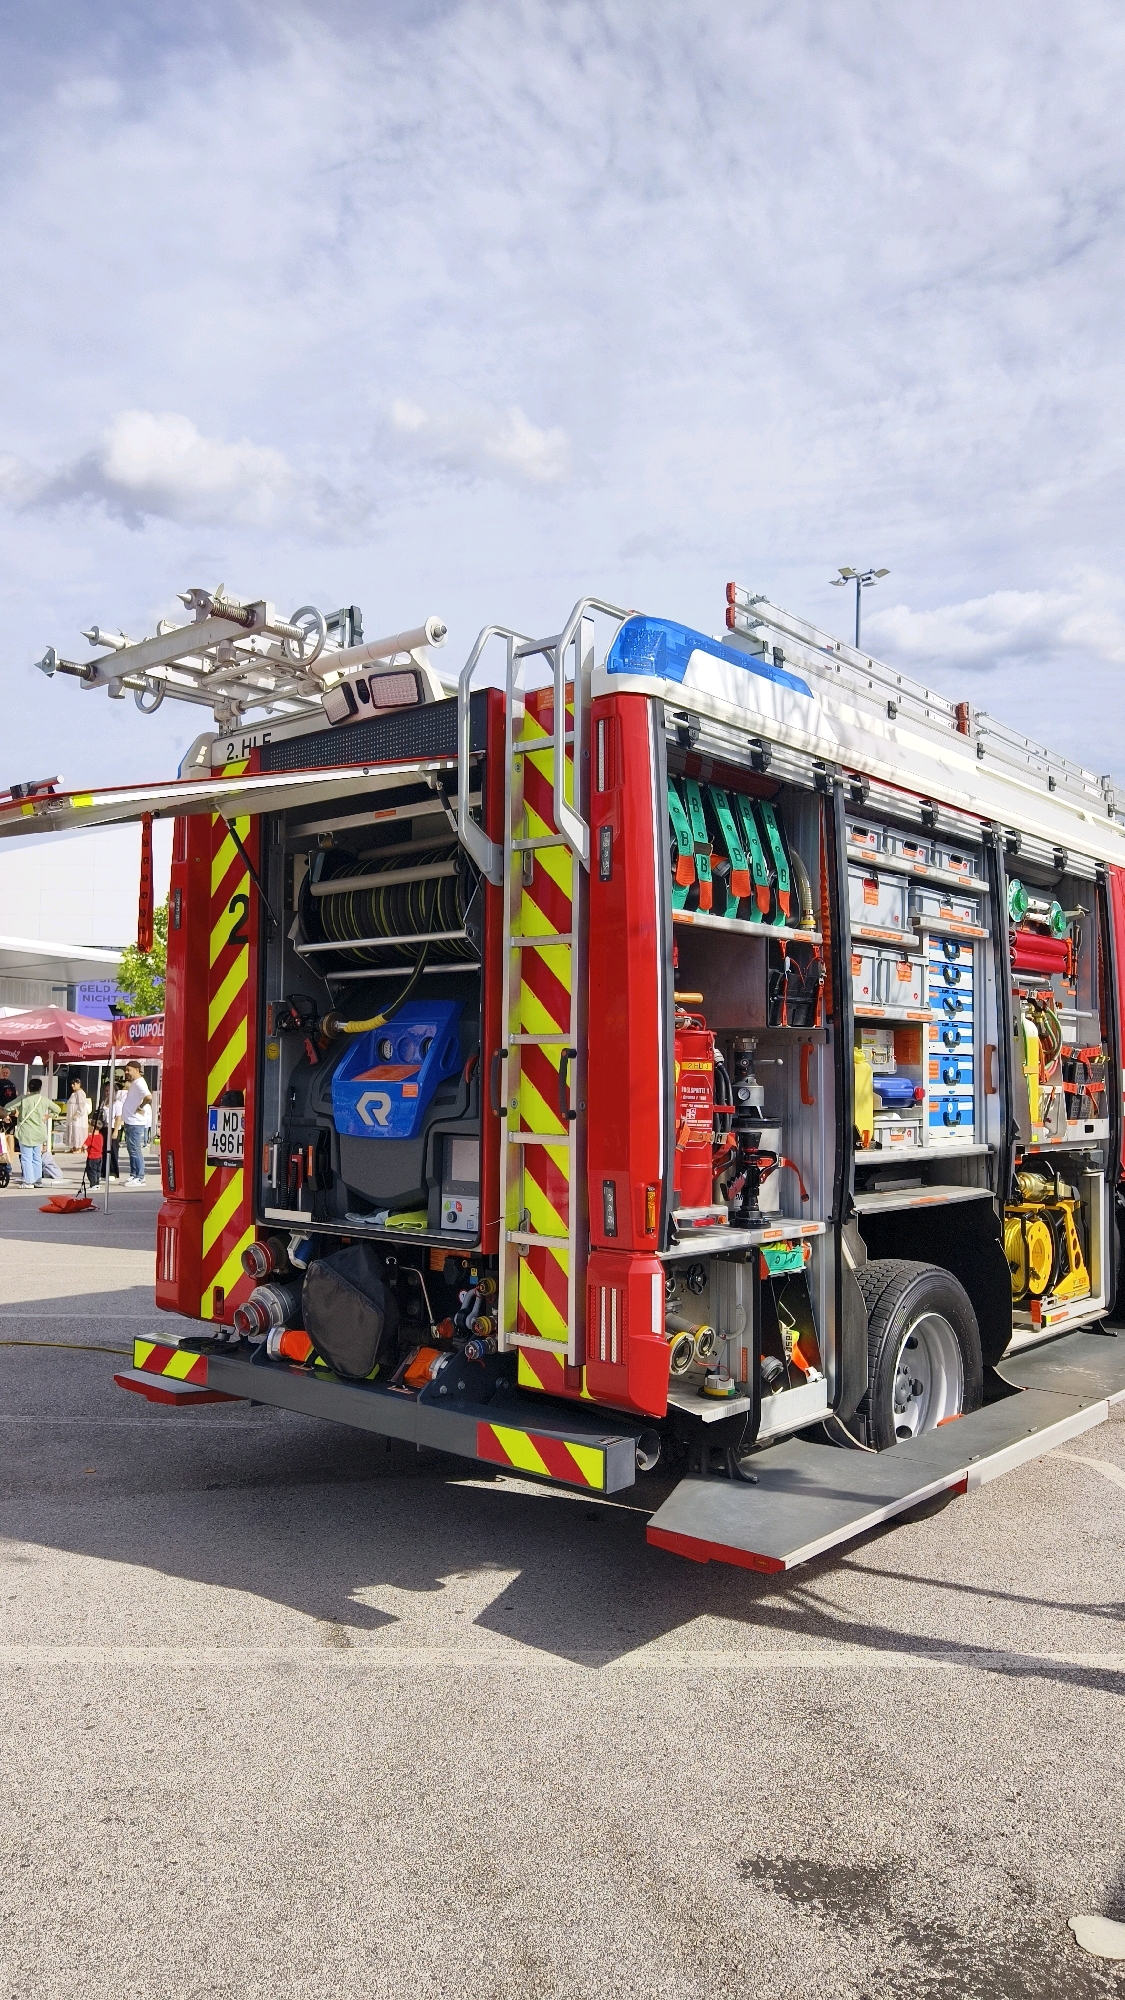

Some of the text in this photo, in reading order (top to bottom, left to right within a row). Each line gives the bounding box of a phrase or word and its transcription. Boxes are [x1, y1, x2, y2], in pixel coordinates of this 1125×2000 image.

[226, 742, 239, 761] 2.
[680, 830, 689, 847] B
[701, 856, 708, 873] B
[756, 862, 763, 878] B
[781, 868, 787, 884] B
[228, 893, 250, 946] 2
[80, 984, 111, 993] GELD
[223, 1112, 239, 1132] MD
[211, 1132, 245, 1155] 496H
